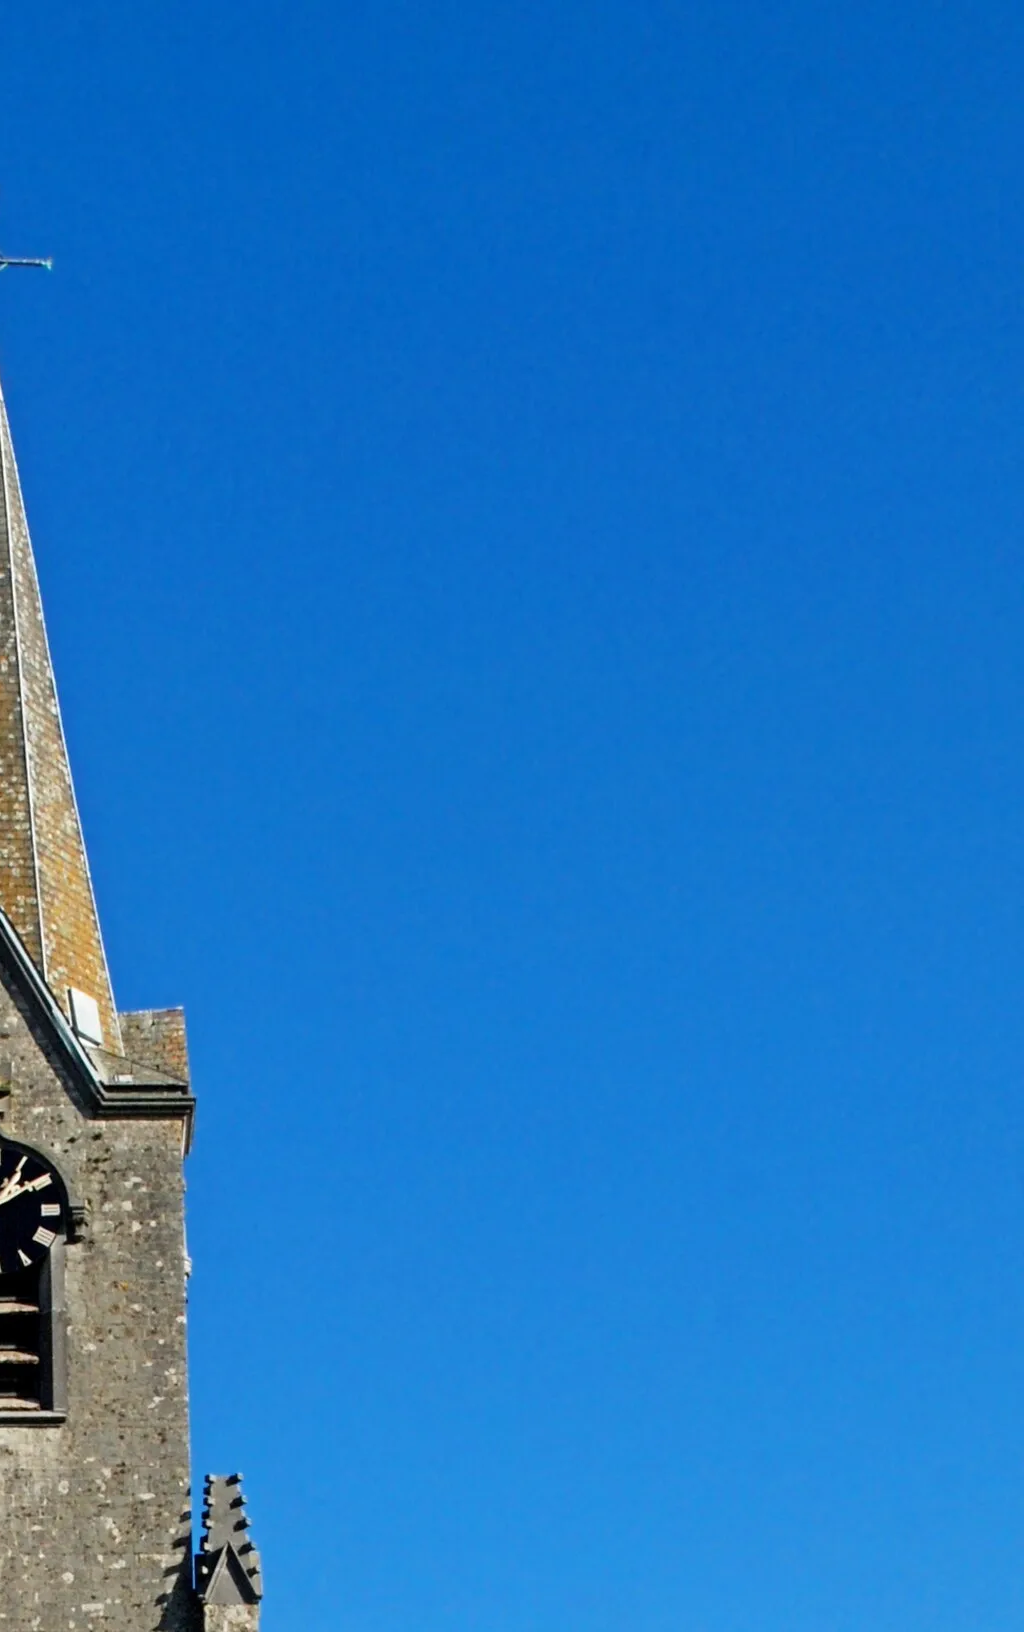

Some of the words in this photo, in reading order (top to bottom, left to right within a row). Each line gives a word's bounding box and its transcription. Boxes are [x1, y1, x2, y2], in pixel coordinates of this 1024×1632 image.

[40, 1203, 61, 1217] III
[32, 1225, 56, 1248] IIII
[17, 1249, 33, 1267] V
